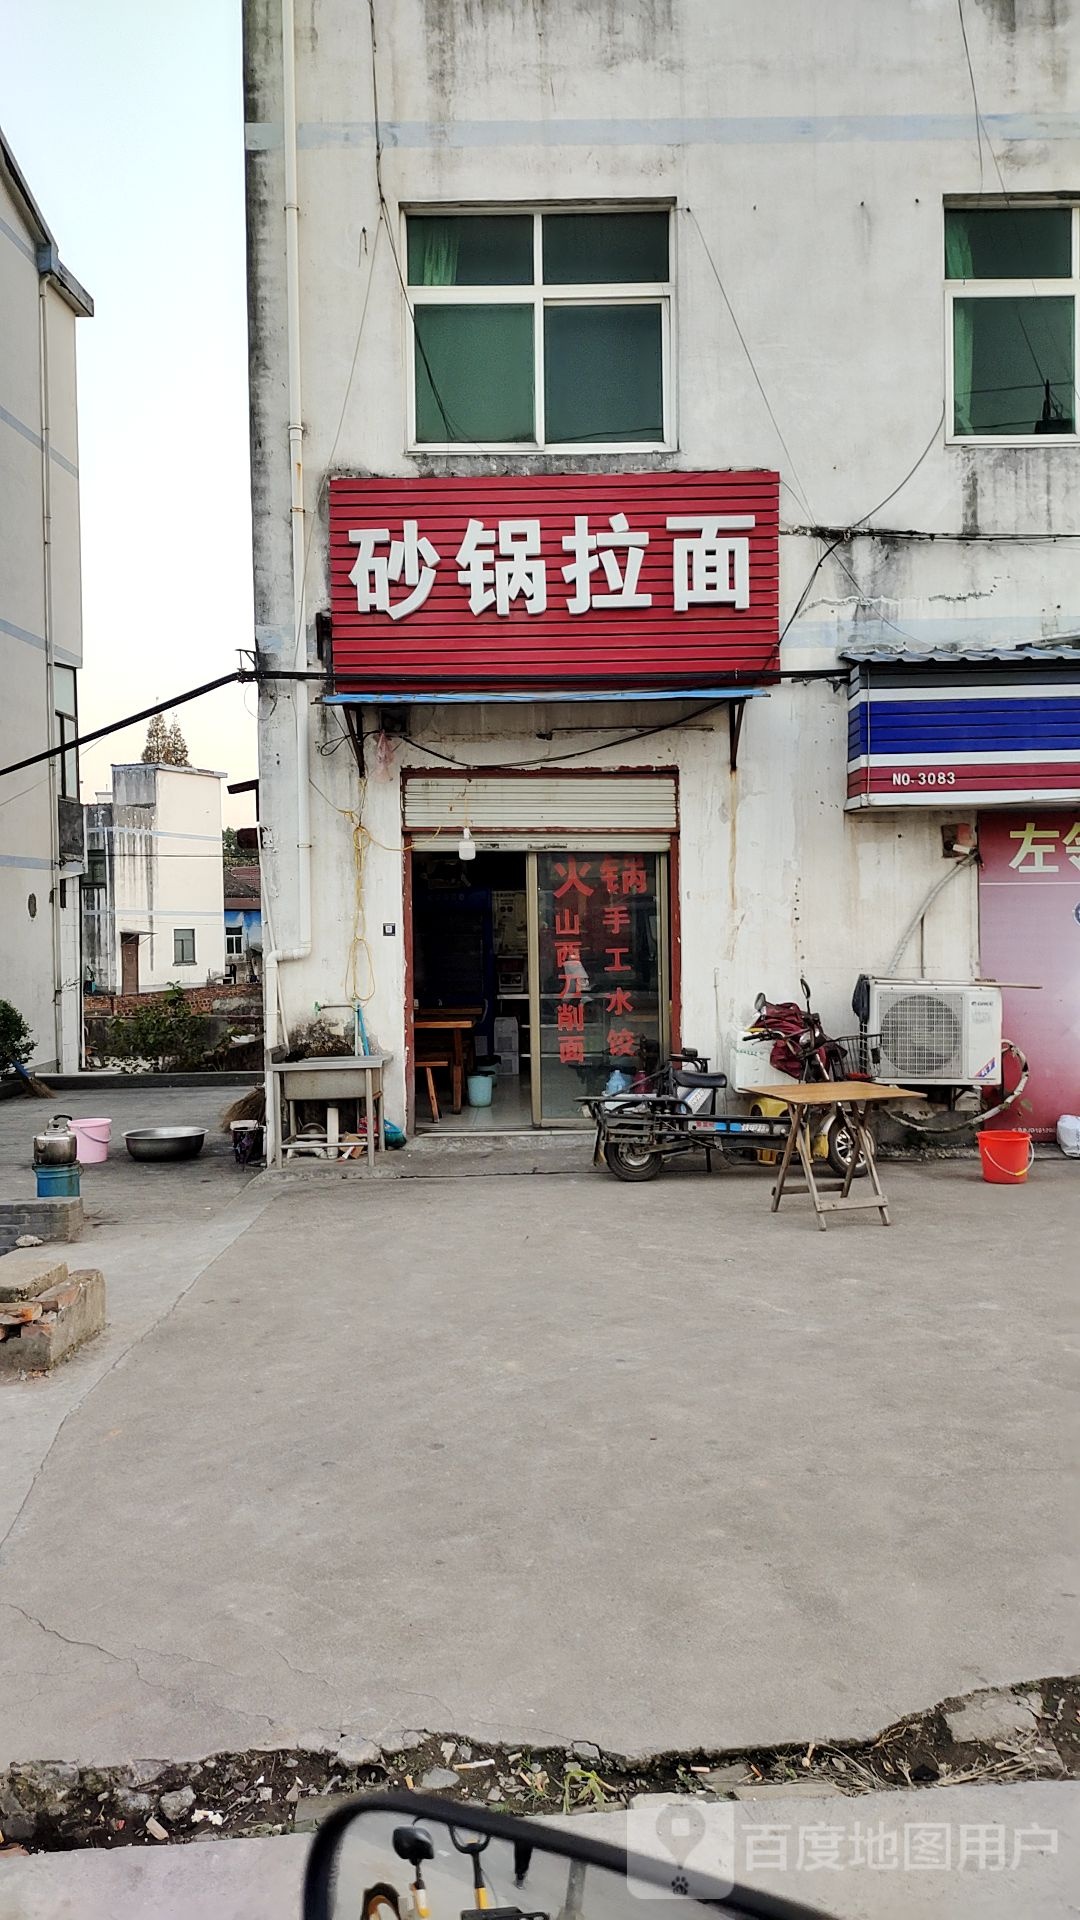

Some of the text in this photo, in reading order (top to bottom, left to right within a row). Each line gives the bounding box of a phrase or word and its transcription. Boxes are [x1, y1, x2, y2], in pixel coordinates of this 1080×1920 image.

[348, 513, 756, 620] 砂锅拉面
[553, 857, 648, 898] 火锅
[554, 909, 585, 1064] 山西刀削面
[603, 906, 638, 1057] 手工水饺
